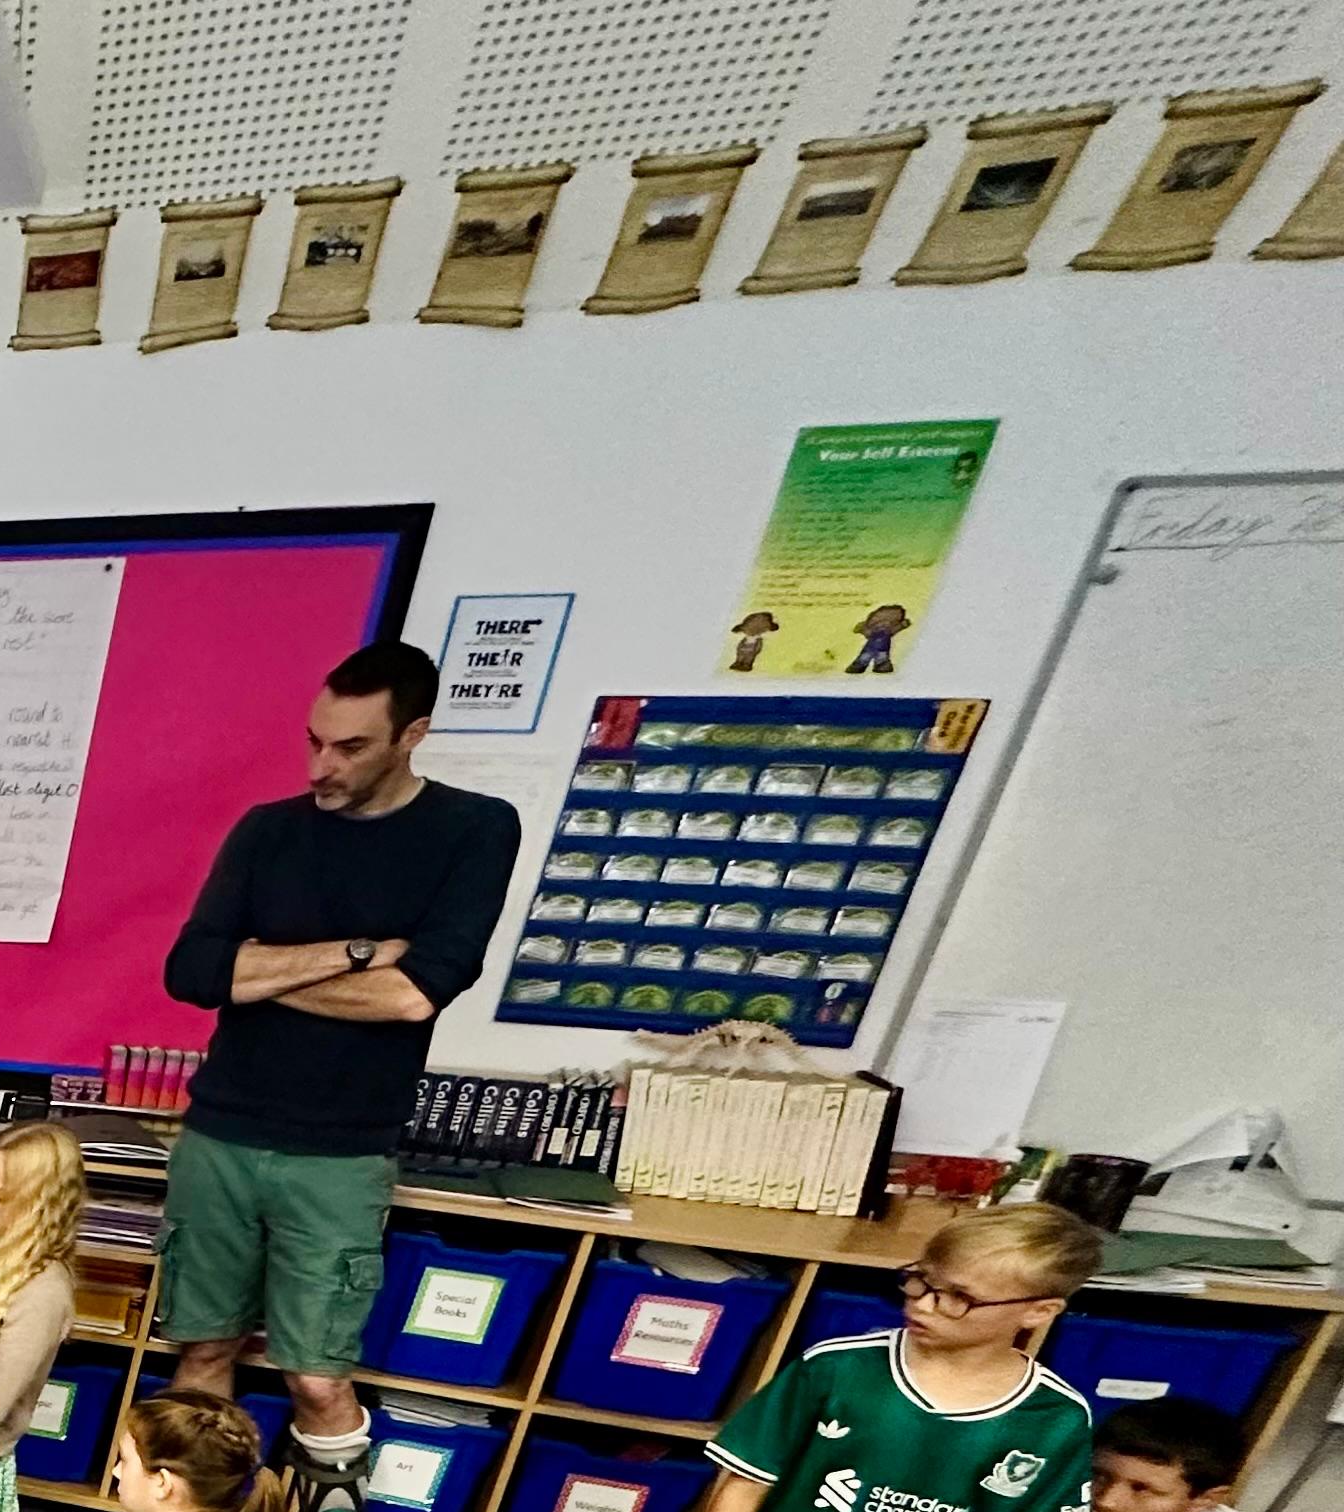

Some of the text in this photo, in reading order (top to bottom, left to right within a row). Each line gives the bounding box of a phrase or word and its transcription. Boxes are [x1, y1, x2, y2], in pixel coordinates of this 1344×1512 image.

[476, 619, 540, 635] THERE
[426, 1080, 451, 1129] Collins
[449, 1082, 474, 1132] Collins
[473, 1086, 498, 1134] Collins
[494, 1088, 520, 1136] Collins
[517, 1089, 543, 1138] Collins
[434, 1291, 476, 1306] Special
[434, 1305, 467, 1319] Books
[650, 1315, 690, 1331] Maths
[632, 1329, 696, 1346] Resources
[396, 1460, 413, 1473] Art
